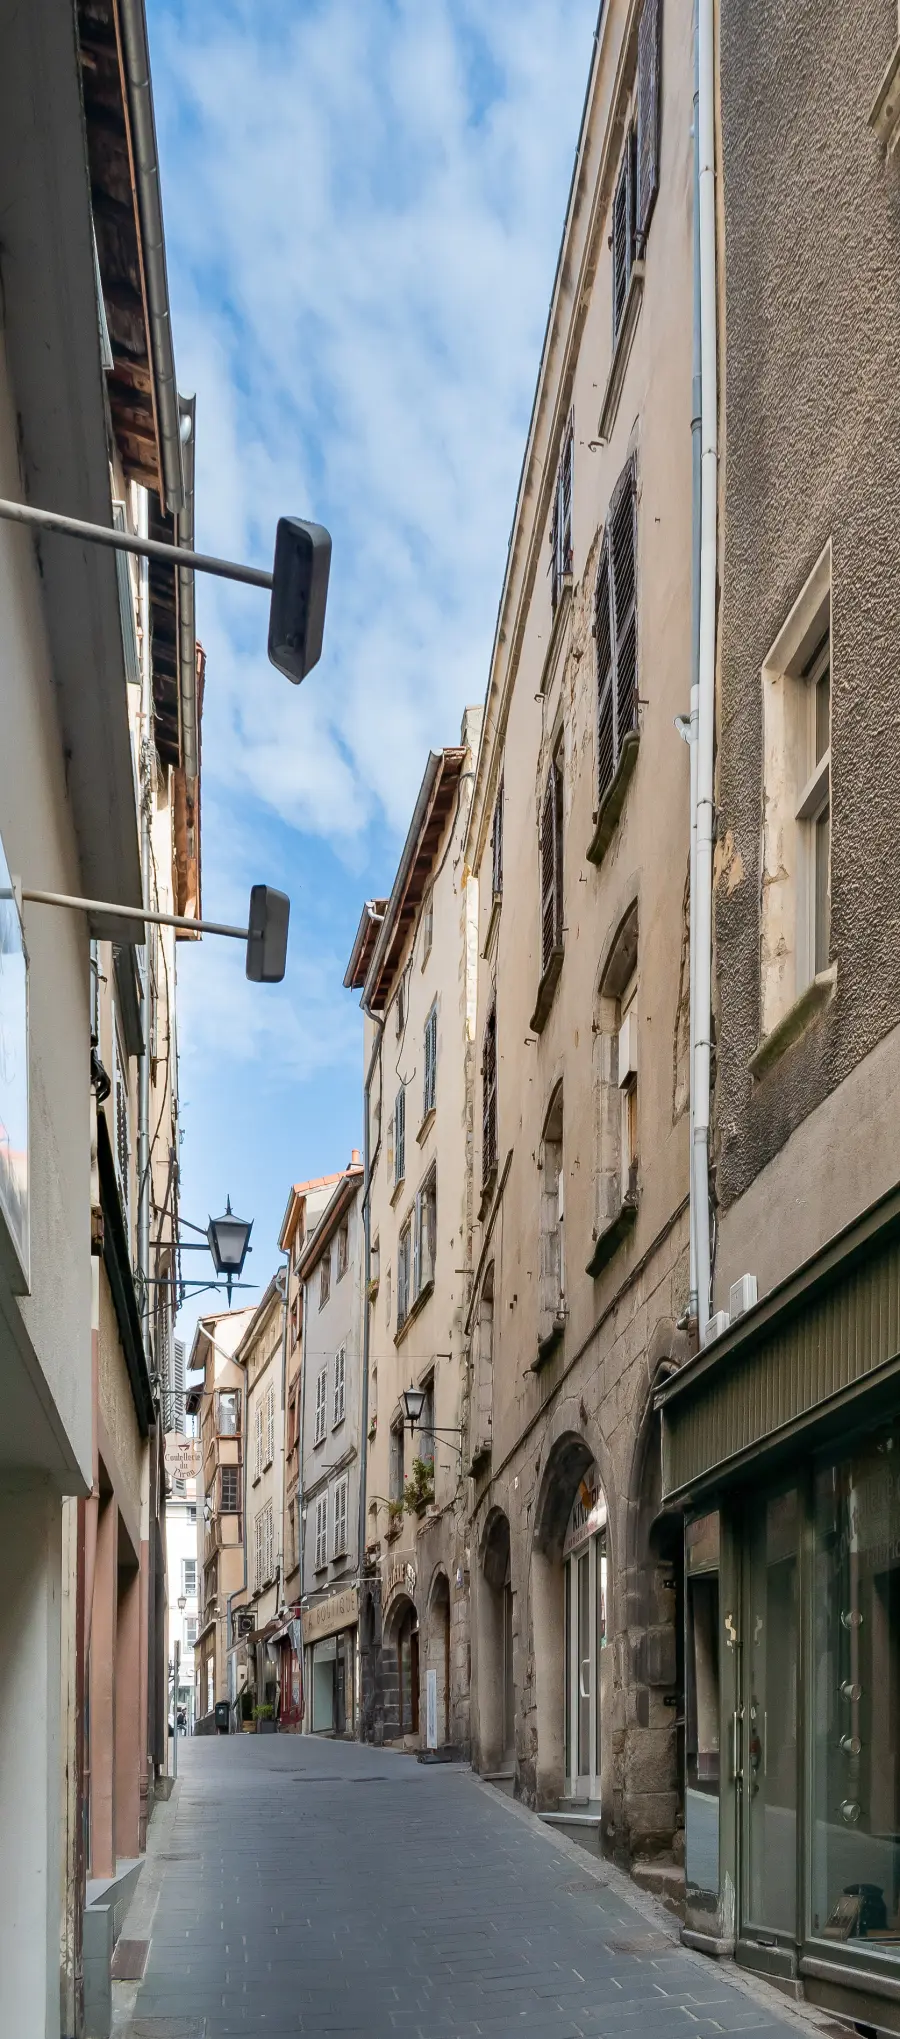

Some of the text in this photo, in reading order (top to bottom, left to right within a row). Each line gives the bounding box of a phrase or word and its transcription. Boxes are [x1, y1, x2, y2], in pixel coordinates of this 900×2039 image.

[180, 1461, 188, 1470] du
[173, 1467, 196, 1478] Piron
[316, 1593, 355, 1625] BOUTIQUE
